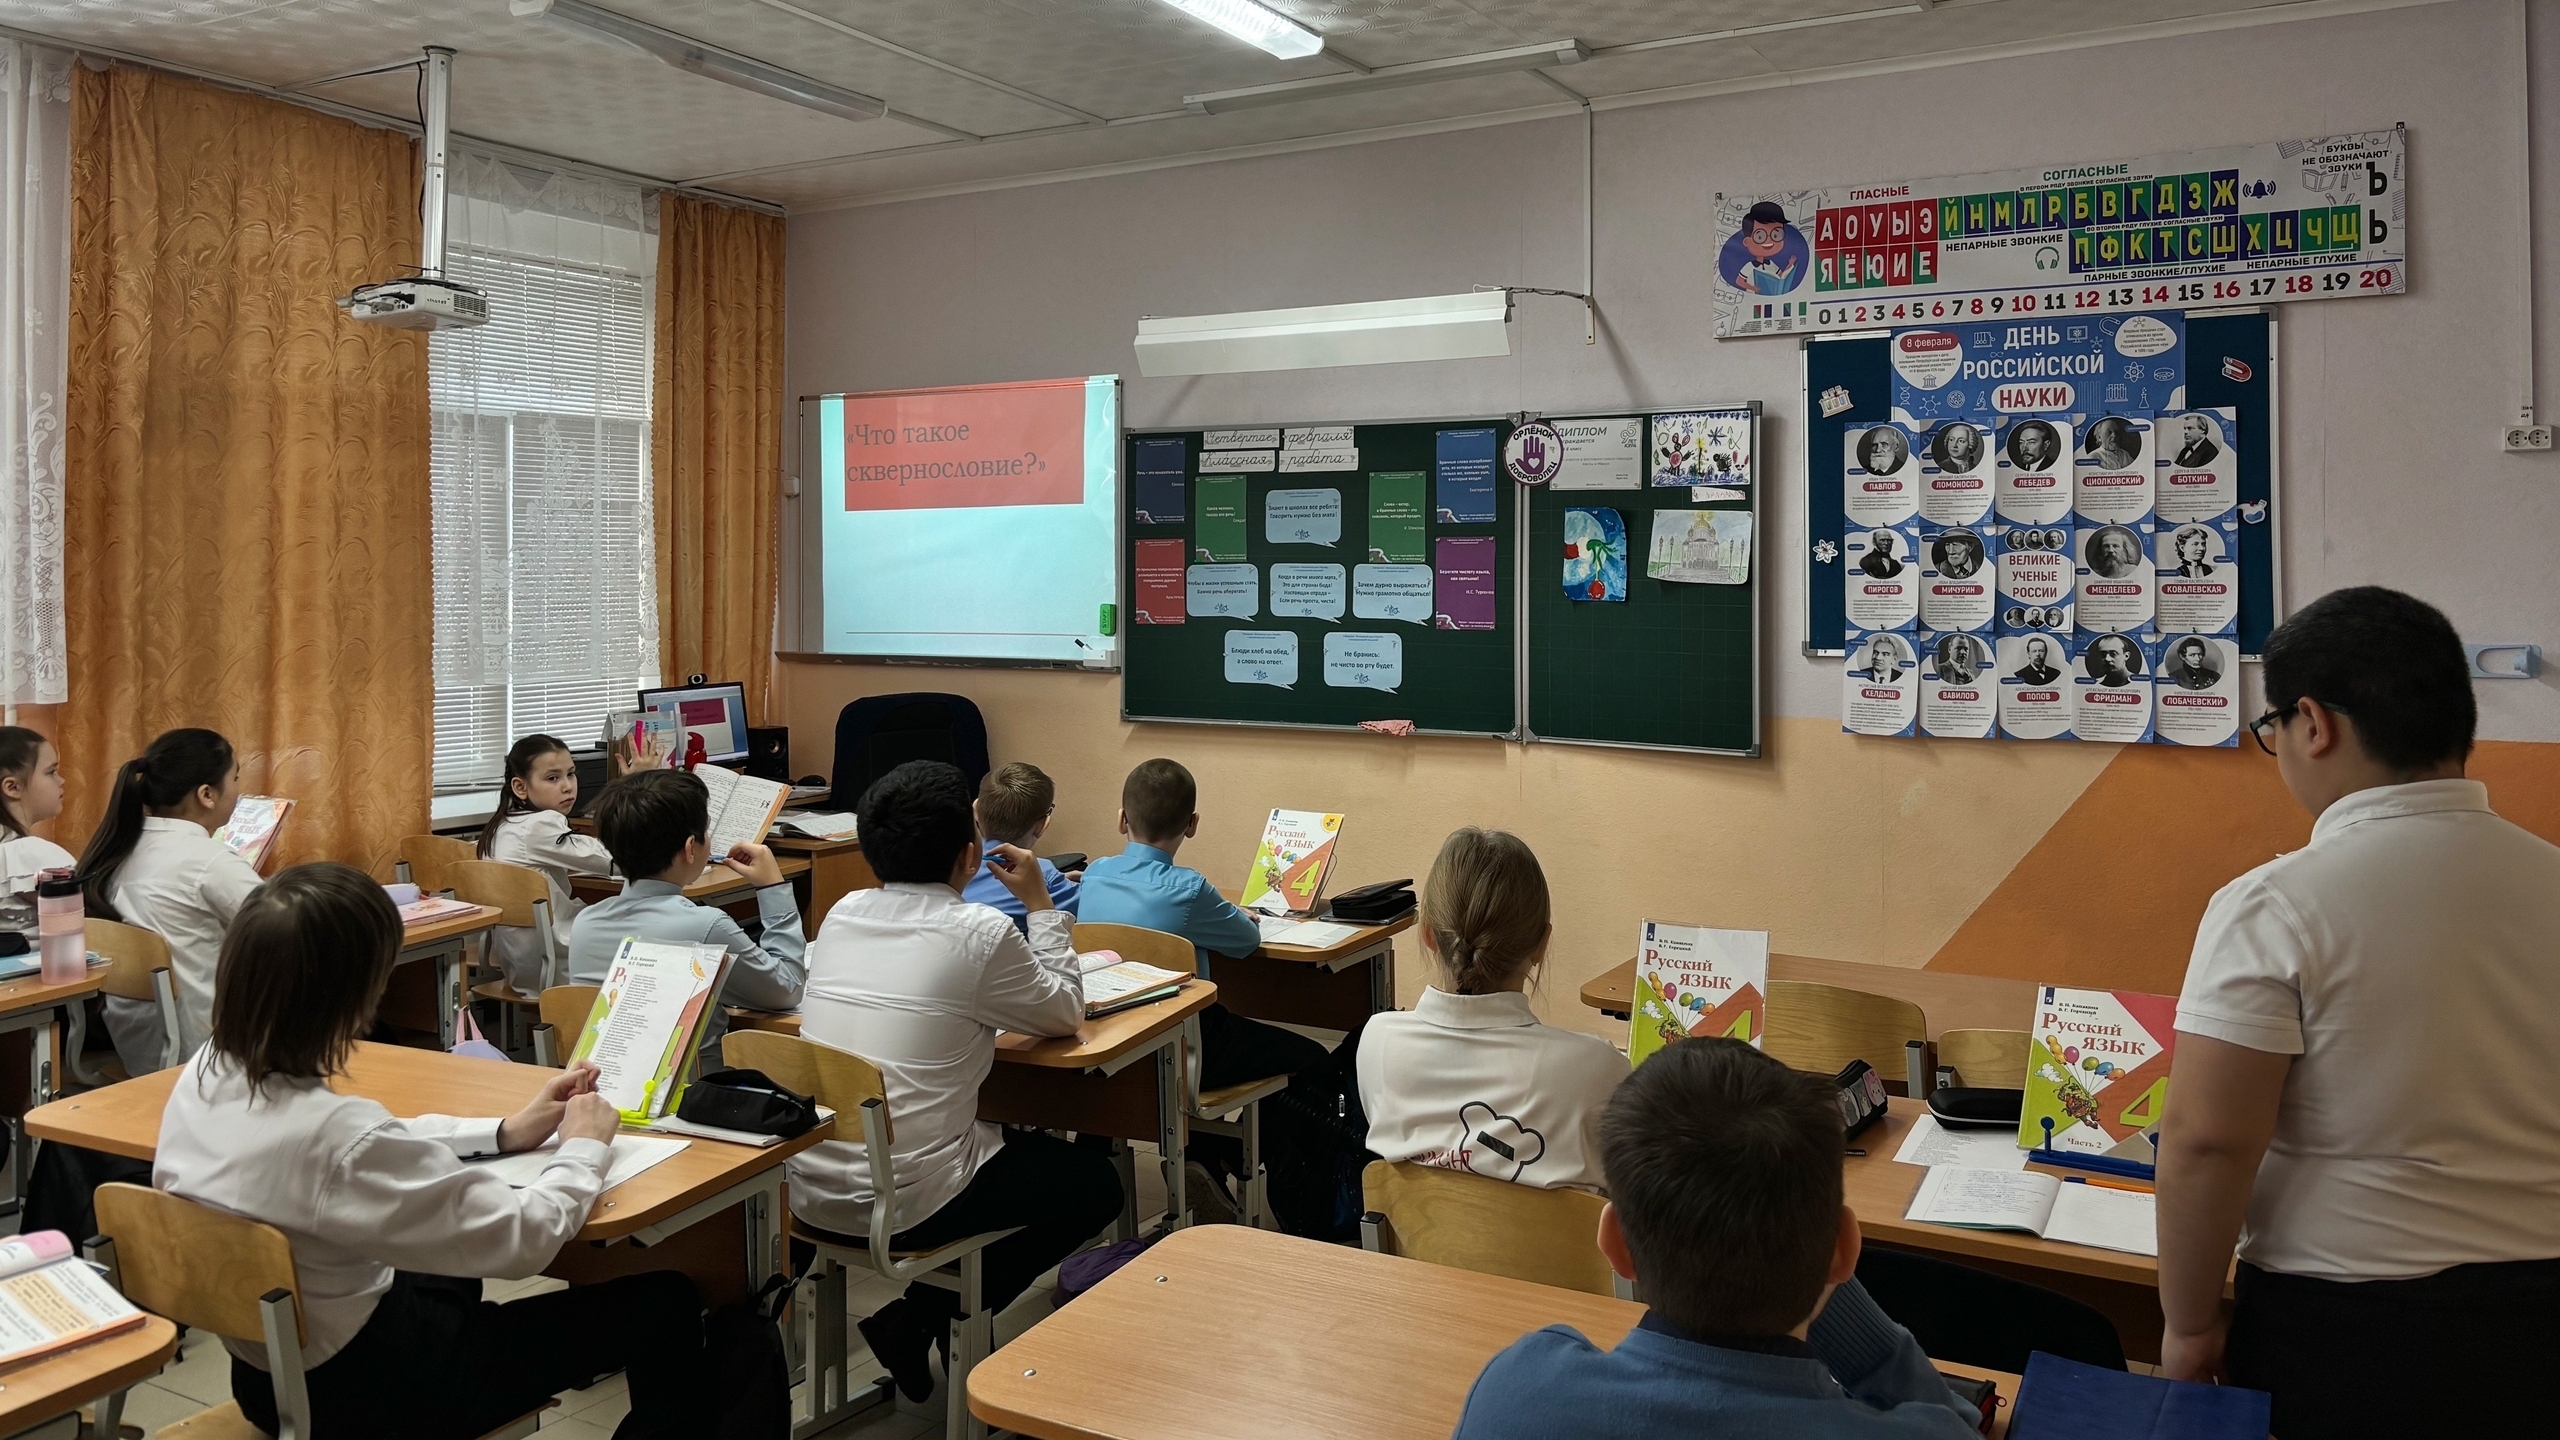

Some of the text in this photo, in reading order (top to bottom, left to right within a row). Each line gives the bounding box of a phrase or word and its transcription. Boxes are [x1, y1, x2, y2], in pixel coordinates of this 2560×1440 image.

[2327, 143, 2364, 153] БУКВЫ
[2302, 151, 2388, 166] НЕ ОБОЗНАЧАЮТ
[2043, 164, 2128, 182] СОГЛАСНЫЕ
[2328, 163, 2363, 174] ЗВУКИ
[1850, 186, 1909, 200] ГЛАСНЫЕ
[1820, 161, 2388, 241] А О У Ы Э Й Н М Л Р Б В Г Д З Ж Ъ
[2139, 220, 2162, 228] ГЛУХИЕ
[2164, 218, 2201, 226] СОГЛАСНЫЕ
[1946, 234, 2064, 252] НЕПАРНЫЕ ЗВОНКИЕ
[2076, 209, 2388, 264] П Ф К Т С Ш Х Ц Ч Щ Ь
[1821, 251, 1931, 284] Я Ё Ю И Е
[2247, 254, 2357, 270] НЕПАРНЫЕ ГЛУХИЕ
[2084, 264, 2226, 282] ПАРНЫЕ ЗВОНКИЕ/ГЛУХИЕ
[1819, 309, 1831, 324] 0
[1839, 308, 1848, 323] 1
[1855, 307, 1867, 323] 2
[1874, 305, 1885, 321] 3
[1892, 304, 1905, 319] 4
[1913, 303, 1924, 318] 5
[1932, 302, 1945, 317] 6
[1952, 300, 1964, 316] 7
[1971, 299, 1984, 315] 8
[1991, 298, 2004, 314] 9
[2012, 295, 2037, 312] 10
[2044, 293, 2067, 311] 11
[2075, 292, 2100, 308] 12
[2108, 289, 2134, 306] 13
[2142, 286, 2169, 304] 14
[2178, 284, 2204, 301] 15
[2213, 281, 2241, 299] 16
[2251, 278, 2276, 296] 17
[2286, 275, 2313, 294] 18
[2323, 273, 2350, 291] 19
[2360, 269, 2391, 288] 20
[1907, 338, 1952, 349] 8 февраля
[2004, 326, 2061, 350] ДЕНЬ
[1964, 349, 2104, 380] РОССИЙСКОЙ
[2000, 387, 2066, 409] НАУКИ
[847, 424, 970, 446] «Что такое
[1290, 428, 1351, 450] февраля
[1513, 426, 1554, 440] ОРЛЁНОК
[1558, 427, 1607, 437] ДИПЛОМ
[847, 452, 1046, 486] сквернословие?»
[1509, 462, 1557, 482] ДОБРОВОЛЕЦ
[1936, 481, 1979, 489] ЛОМОНОСОВ
[2019, 479, 2051, 487] ЛЕБЕДЕВ
[2086, 475, 2141, 486] ЦИОЛКОВСКИЙ
[2009, 555, 2061, 566] ВЕЛИКИЕ
[2012, 571, 2058, 582] УЧЕНЫЕ
[1868, 586, 1899, 594] ПИРОГОВ
[1942, 586, 1976, 594] МИЧУРИН
[2013, 587, 2057, 598] РОССИИ
[2092, 586, 2136, 594] МЕНДЕЛЕЕВ
[1866, 691, 1897, 699] КЕЛДЫШ
[1943, 692, 1975, 700] ВАВИЛОВ
[2094, 694, 2132, 703] ФРИДМАН
[2167, 697, 2223, 706] ЛОБАЧЕВСКИЙ
[1268, 825, 1306, 839] Русский
[1291, 860, 1321, 897] 4
[1644, 949, 1713, 972] Русский
[1679, 974, 1732, 990] язык
[2042, 1013, 2122, 1037] Русский
[2082, 1037, 2146, 1056] язык
[2120, 1077, 2169, 1128] 4
[2068, 1137, 2094, 1148] Часть
